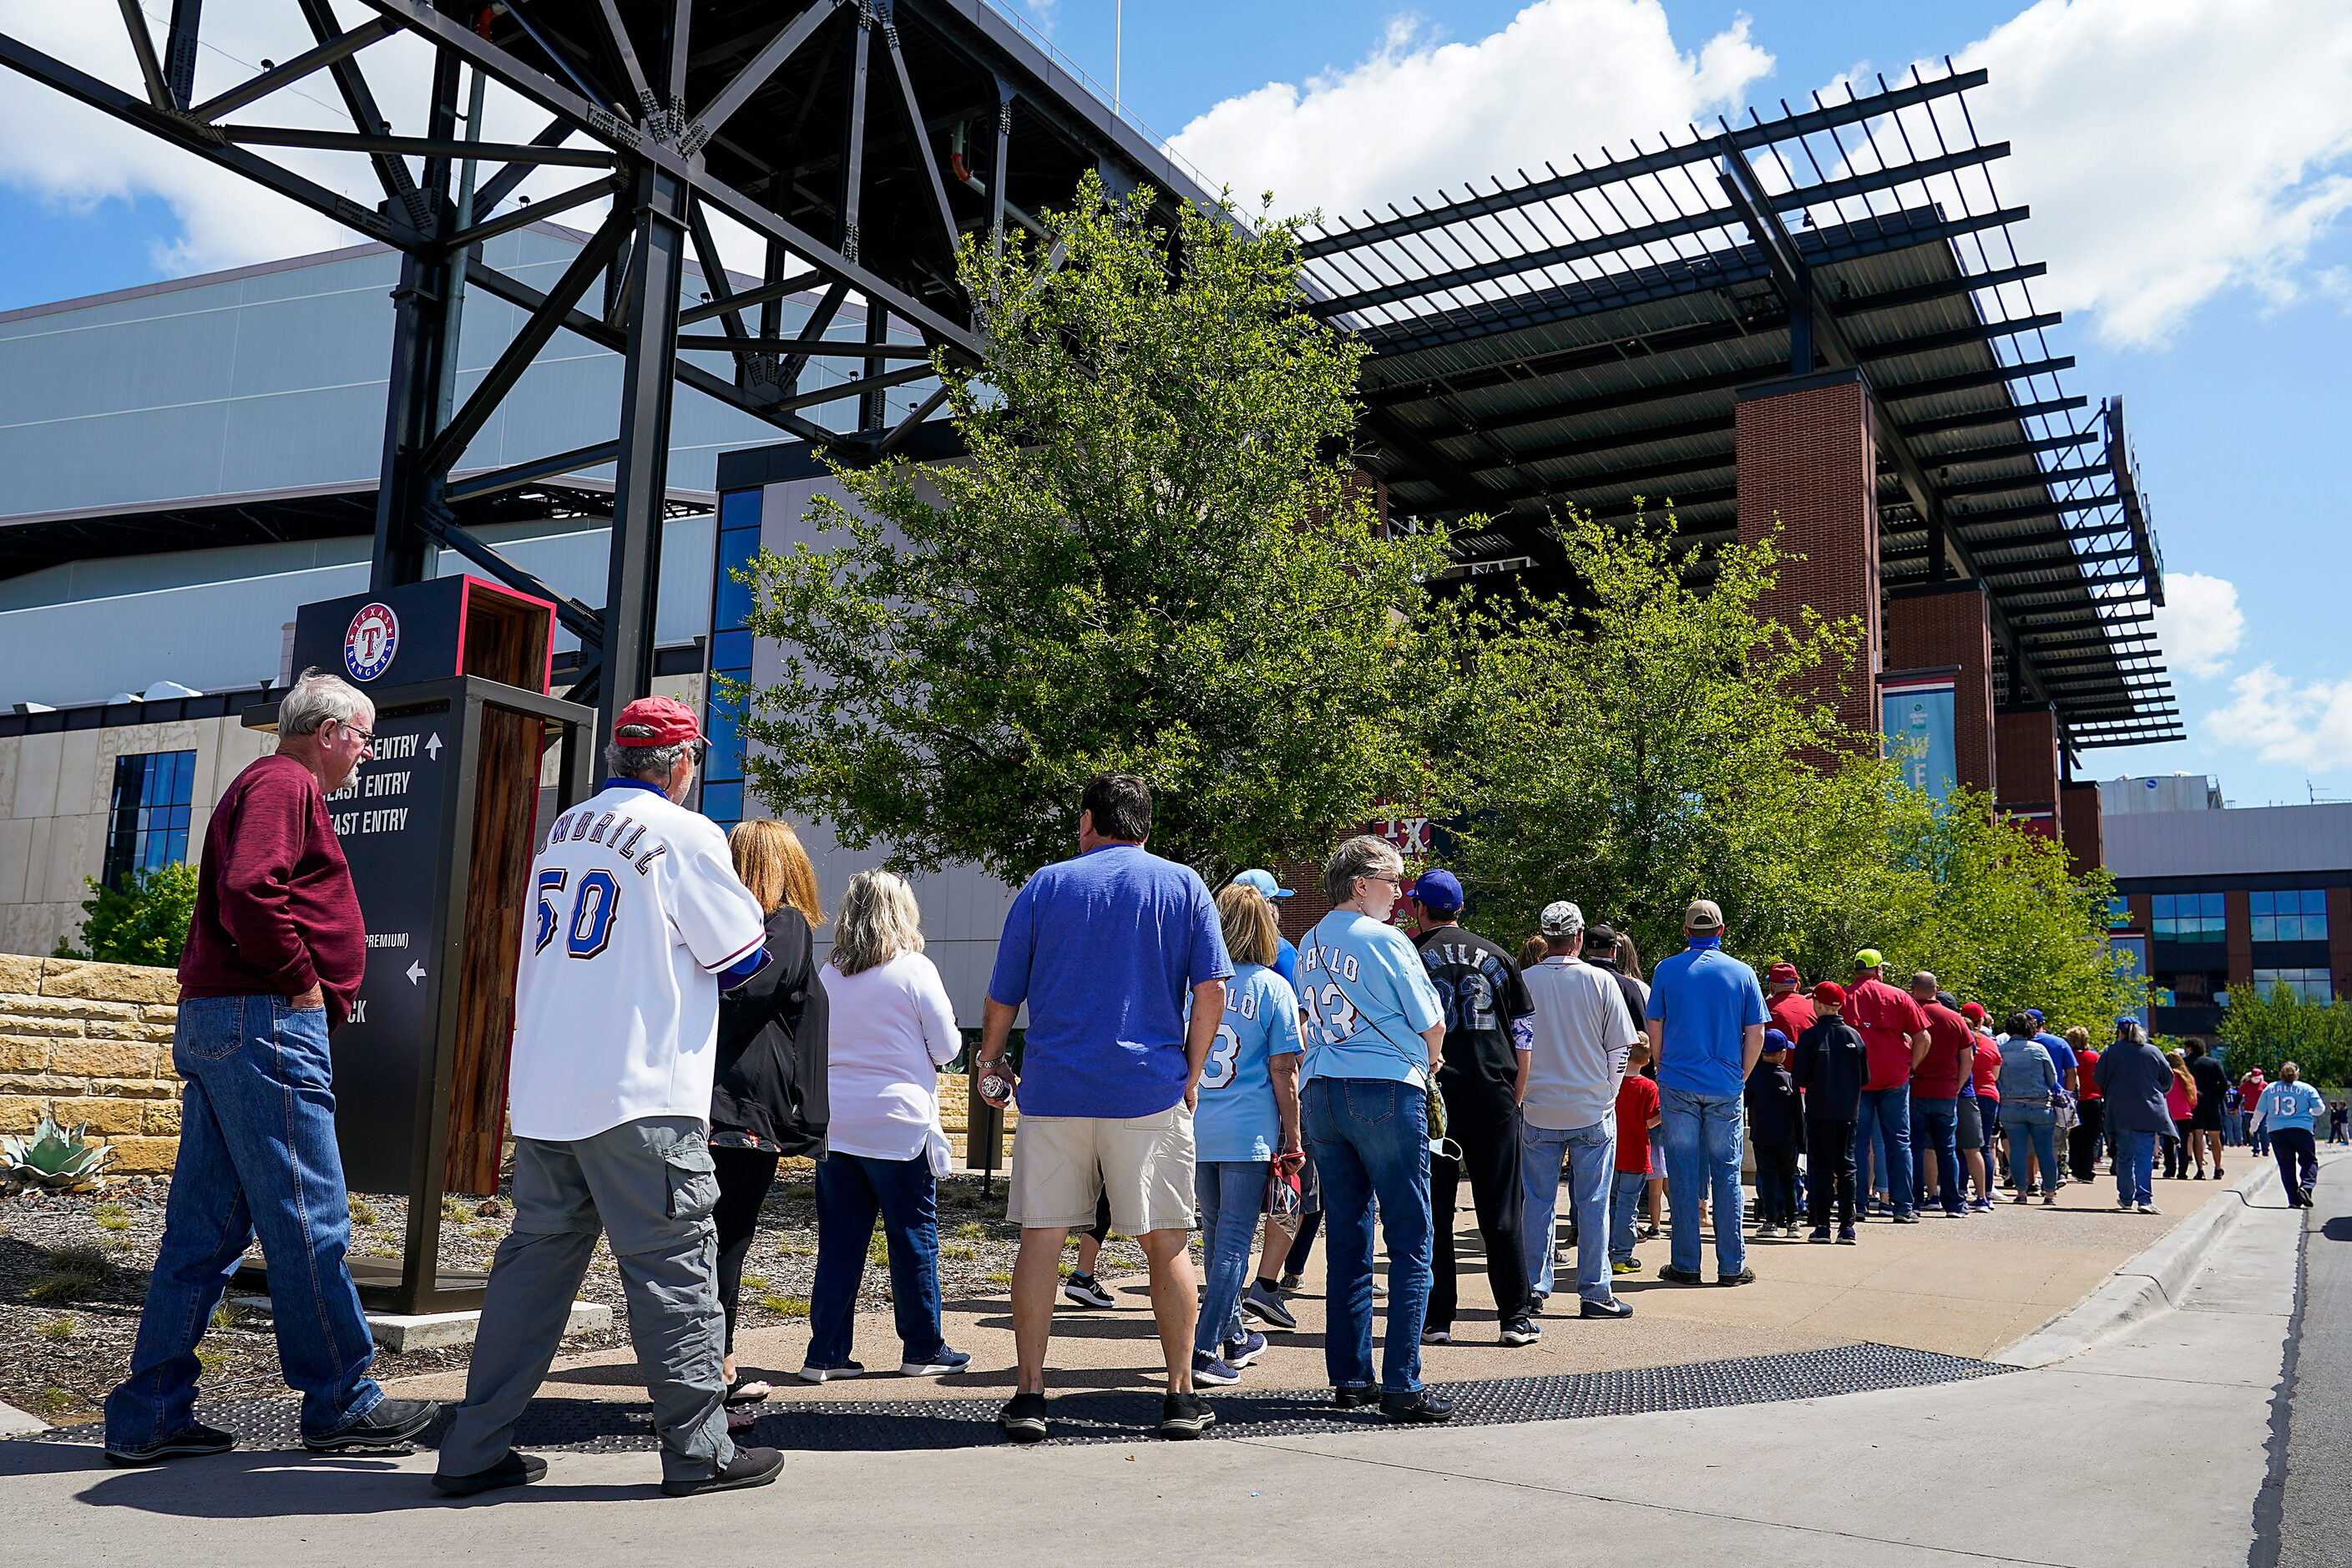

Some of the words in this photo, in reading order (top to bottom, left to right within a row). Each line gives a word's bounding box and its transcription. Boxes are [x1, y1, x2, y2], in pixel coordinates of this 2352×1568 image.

[353, 608, 391, 629] TEXAS
[362, 627, 382, 660] T
[347, 645, 392, 676] RANGERS
[373, 734, 419, 761] ENTRY
[364, 771, 411, 797] ENTRY
[330, 812, 359, 836] AST
[362, 807, 408, 833] ENTRY
[535, 868, 621, 960] 50
[1419, 943, 1509, 989] MILTON
[347, 1000, 367, 1024] CK
[1303, 983, 1358, 1044] 13
[2270, 1085, 2303, 1095] GALLO
[2274, 1095, 2297, 1116] 13
